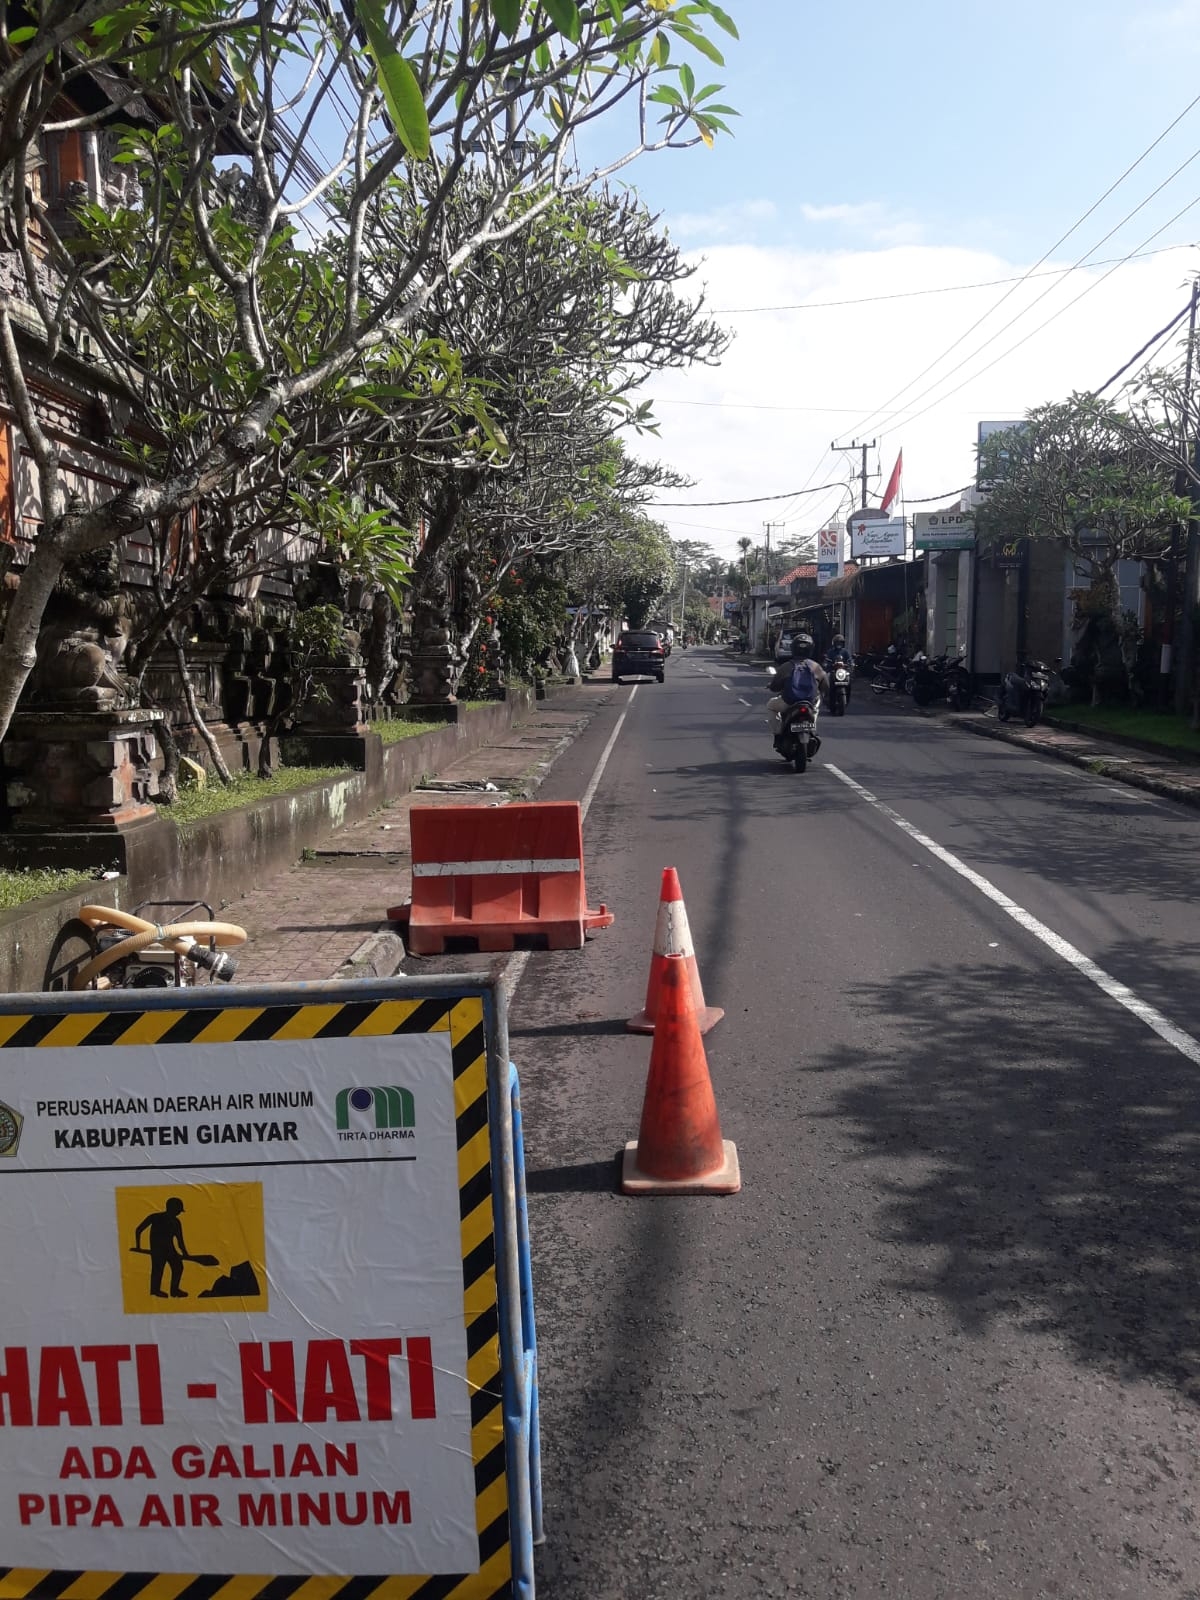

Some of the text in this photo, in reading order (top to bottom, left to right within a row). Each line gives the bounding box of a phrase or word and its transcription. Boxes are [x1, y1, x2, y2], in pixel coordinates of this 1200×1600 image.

[941, 516, 963, 524] LPD
[37, 1091, 314, 1117] PERUSAHAAN DAERAH AIR MINUM
[54, 1121, 299, 1149] KABUPATEN GIANYAR
[336, 1130, 416, 1142] TIRTA DHARMA
[239, 1336, 437, 1424] HATI
[59, 1442, 359, 1480] ADA GALIAN
[18, 1490, 412, 1528] PIPA AIR MINUM
